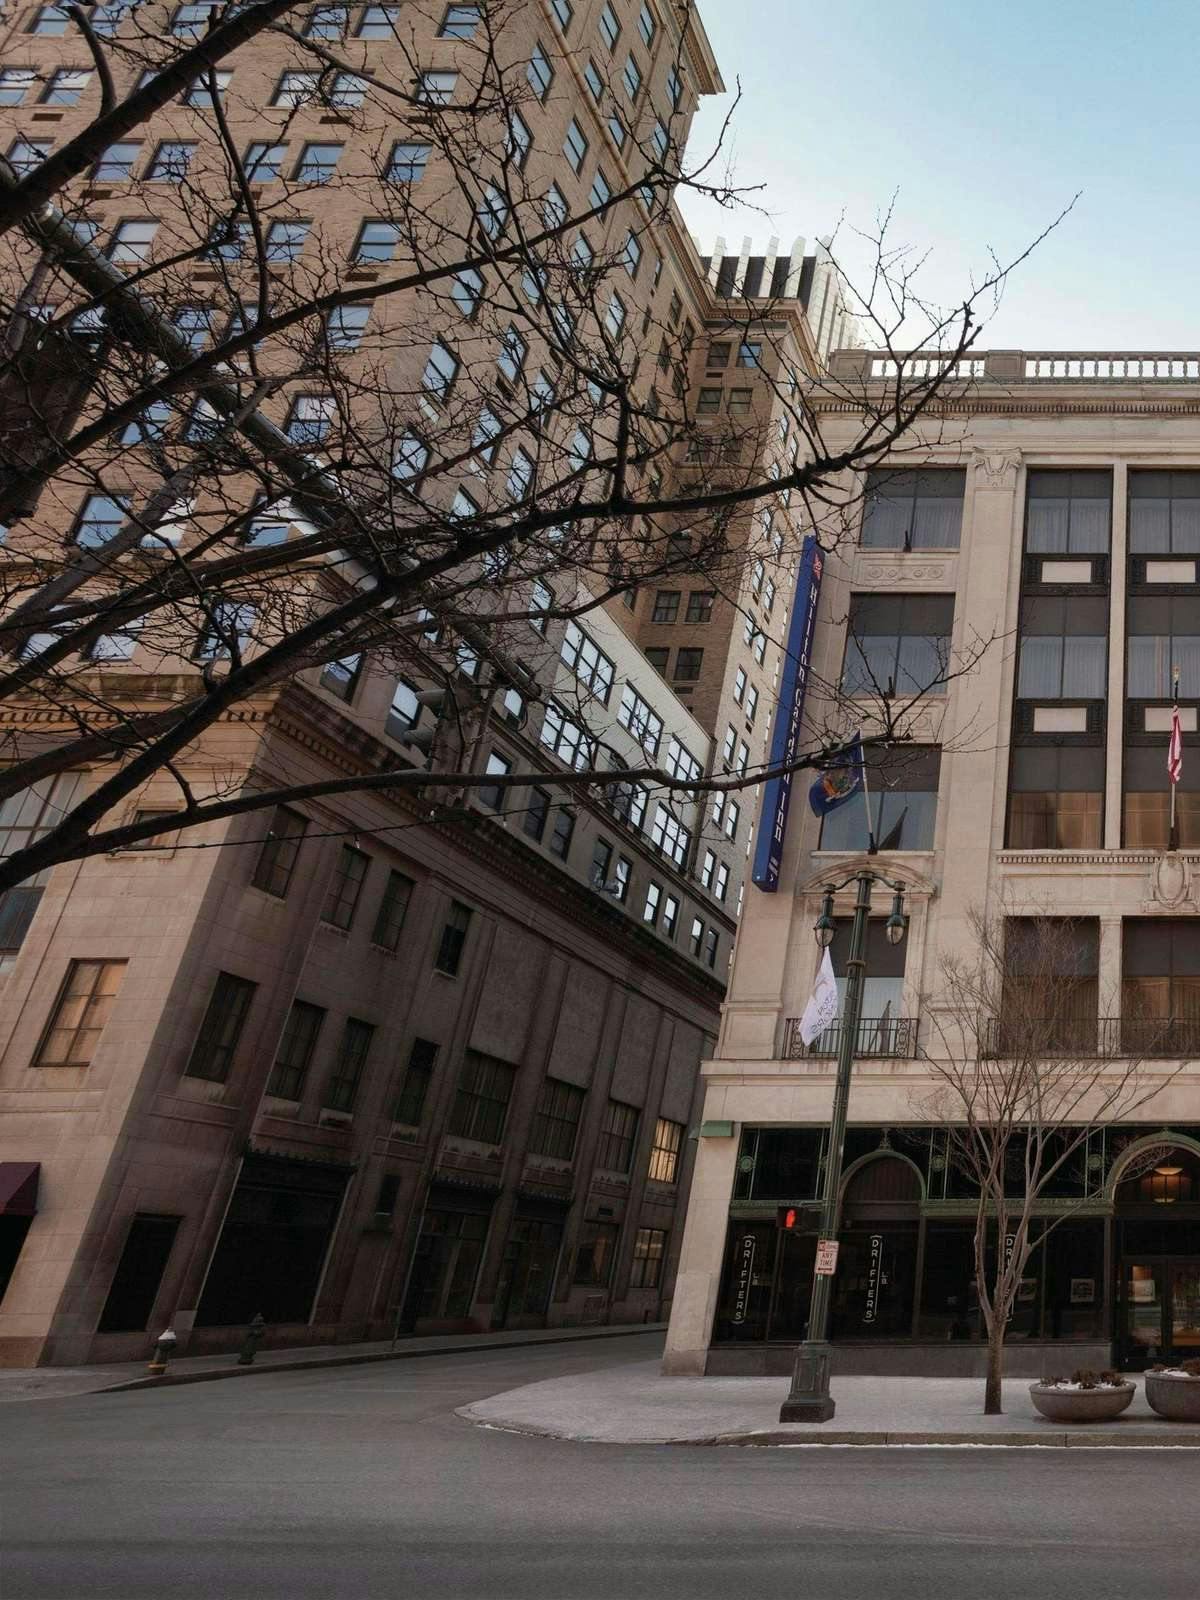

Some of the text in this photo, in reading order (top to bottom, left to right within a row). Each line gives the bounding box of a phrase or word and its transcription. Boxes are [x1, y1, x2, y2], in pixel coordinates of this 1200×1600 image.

[800, 583, 818, 683] Hilton
[775, 791, 786, 842] Inn
[736, 1240, 752, 1319] DRIFTERS
[866, 1240, 879, 1318] DRIFTERS
